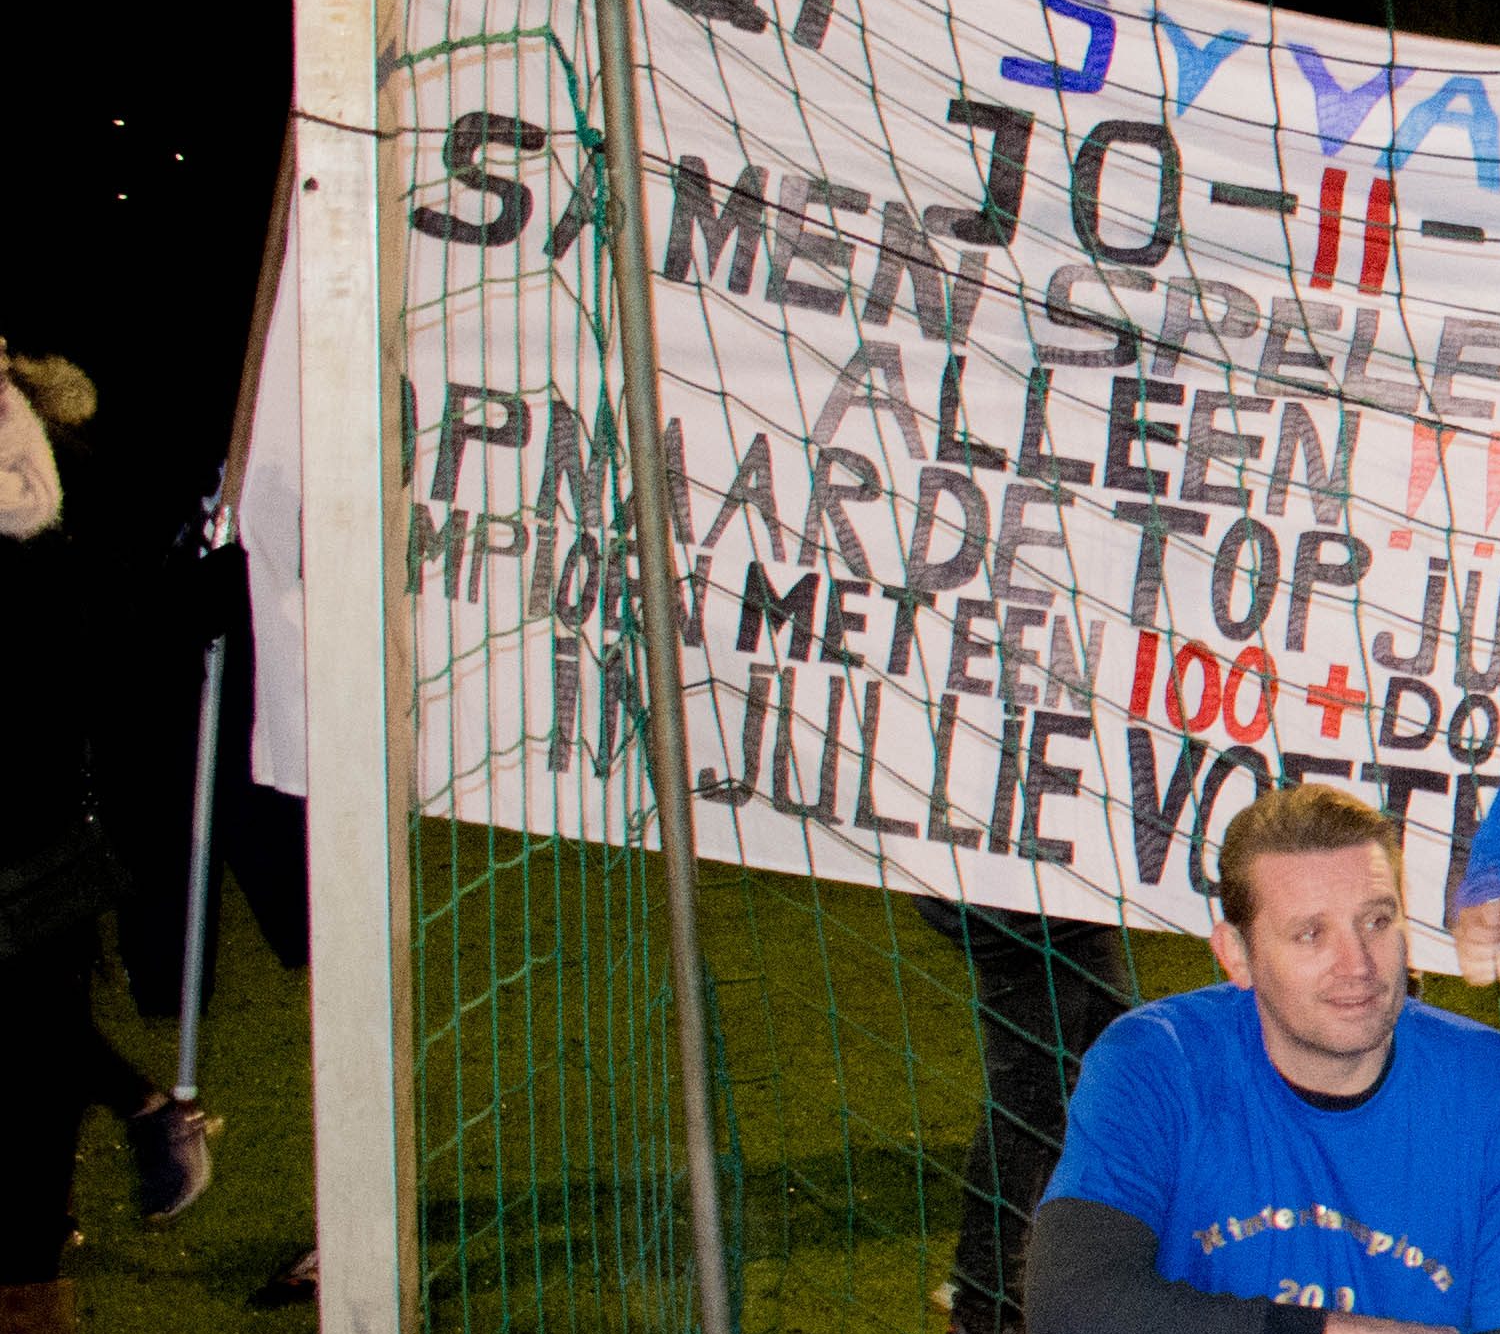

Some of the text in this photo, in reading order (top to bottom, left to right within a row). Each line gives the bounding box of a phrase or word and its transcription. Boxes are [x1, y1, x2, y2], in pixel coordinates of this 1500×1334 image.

[401, 375, 532, 501] P
[1114, 500, 1373, 653] TOP
[812, 340, 1361, 526] ALLEEN
[698, 662, 1093, 865] JULLIE
